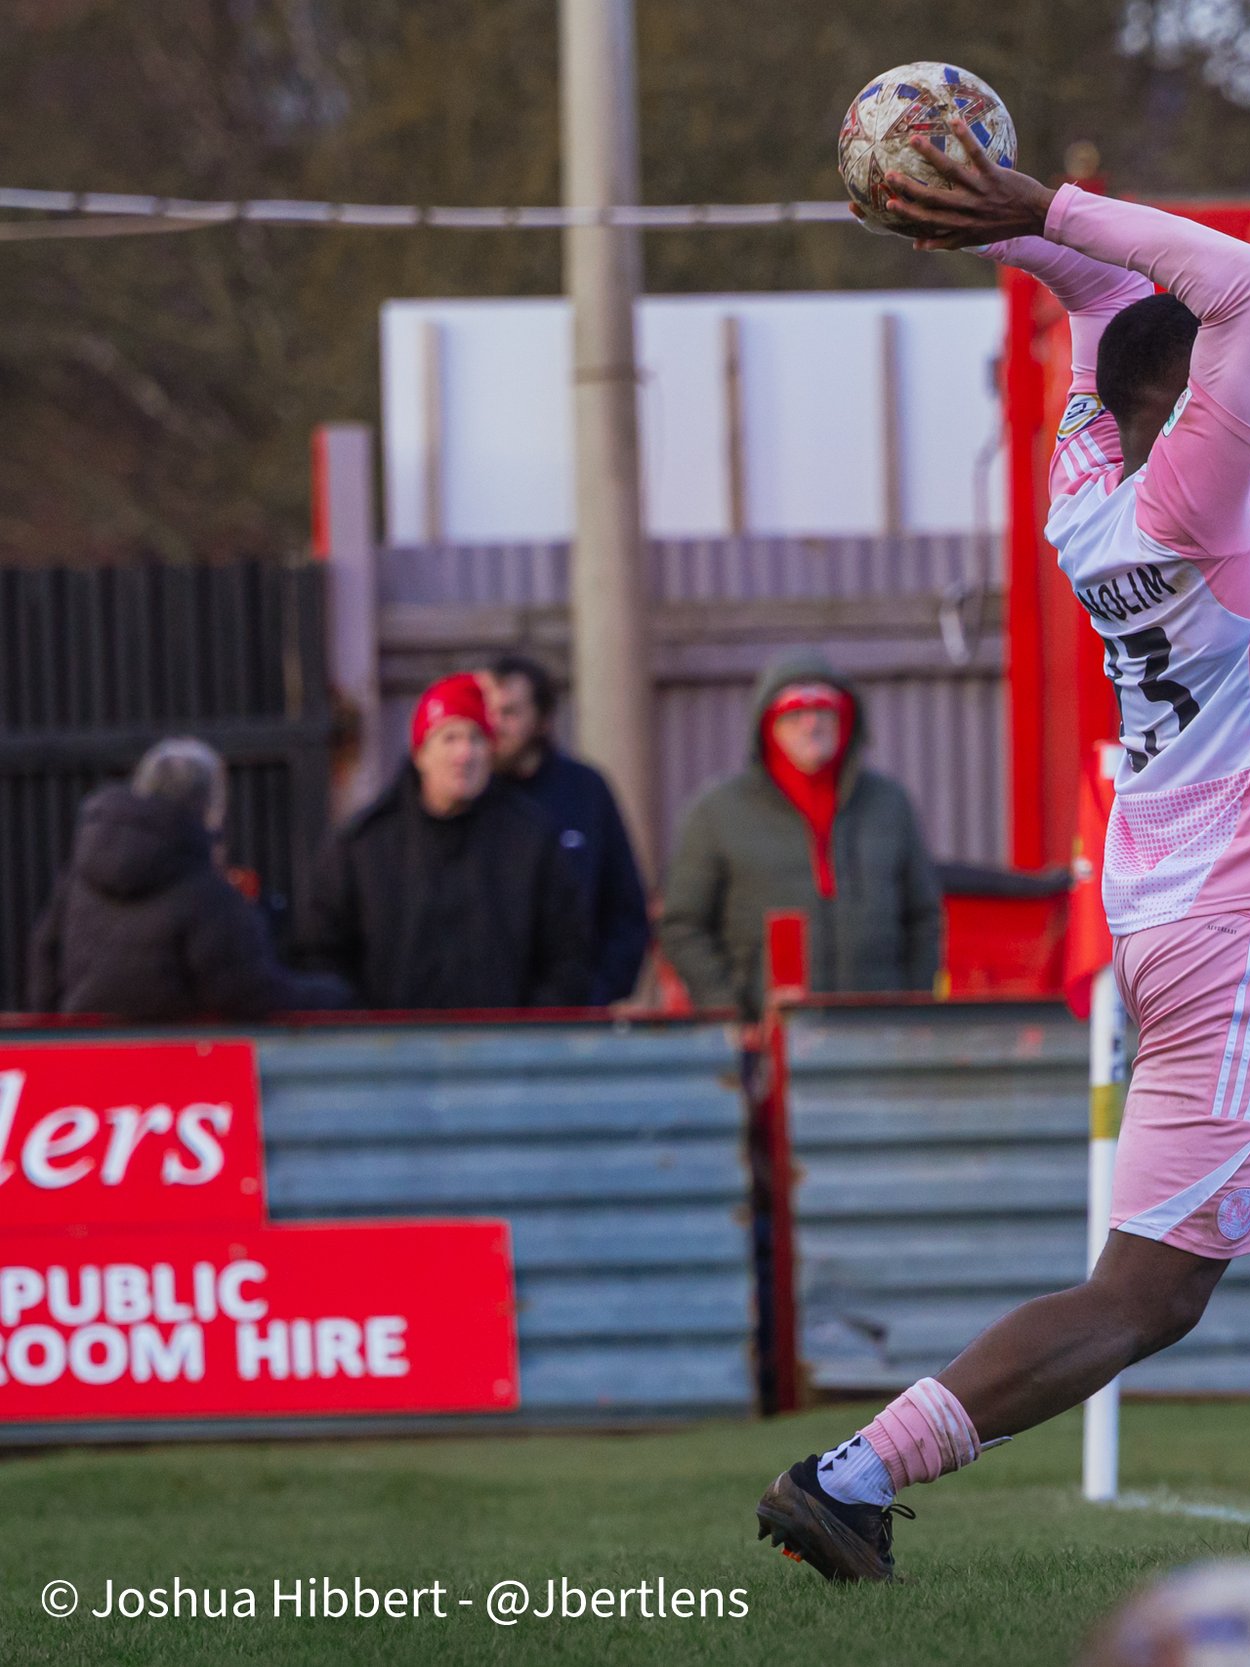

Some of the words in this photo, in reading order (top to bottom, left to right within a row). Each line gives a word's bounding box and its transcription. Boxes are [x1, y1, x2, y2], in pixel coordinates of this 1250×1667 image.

[0, 1259, 268, 1326] PUBLIC
[0, 1323, 204, 1386] OOM
[236, 1316, 410, 1380] HIRE
